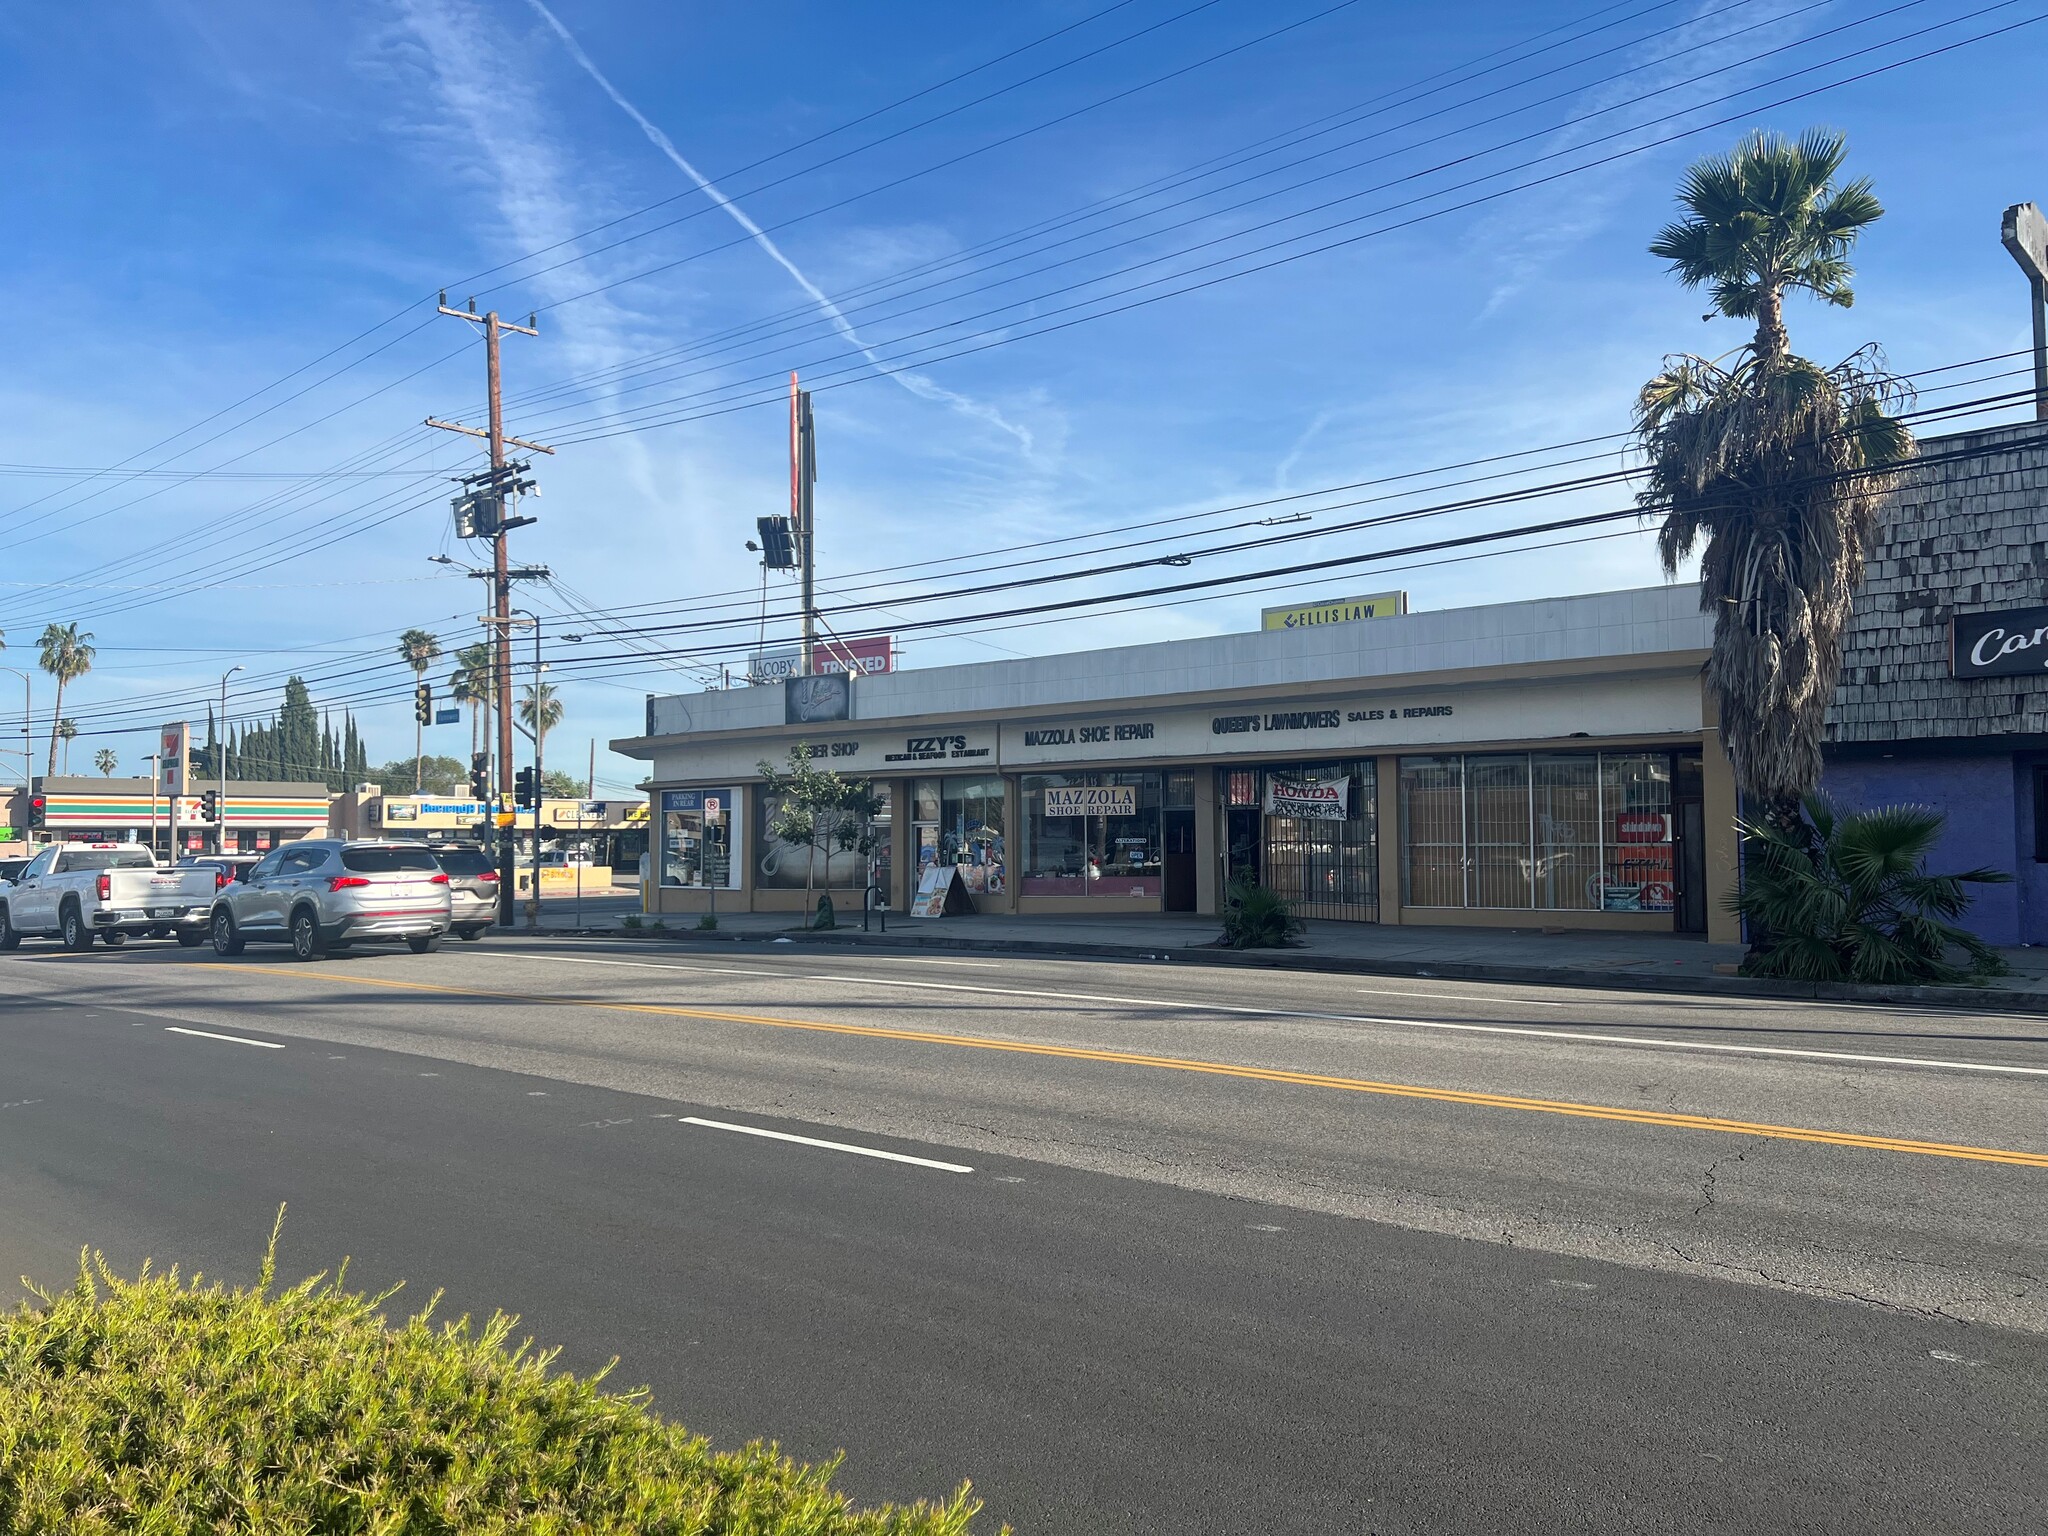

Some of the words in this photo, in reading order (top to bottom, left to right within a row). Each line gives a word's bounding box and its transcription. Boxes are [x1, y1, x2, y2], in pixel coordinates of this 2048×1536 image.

[1300, 609, 1338, 626] ELLIS
[1345, 604, 1375, 621] LAW
[753, 658, 796, 679] JACOBY
[821, 656, 886, 674] TRUSTED
[1212, 714, 1260, 735] QUEEN'S
[1264, 709, 1341, 731] LAWNMOWERS
[1347, 710, 1384, 722] SALES
[1389, 709, 1398, 719] &
[1403, 705, 1453, 718] REPAIRS
[907, 735, 967, 753] IZZY'S
[1024, 728, 1076, 747] MAZZOLA
[1079, 726, 1110, 743] SHOE
[1114, 723, 1154, 741] REPAIR
[791, 744, 828, 760] BBER
[831, 742, 859, 757] SHOP
[918, 751, 947, 760] SEAFOOD
[671, 792, 696, 801] PARKING
[1047, 789, 1133, 806] MAZZOLA
[1272, 784, 1339, 799] HONDA
[680, 799, 694, 807] REAR
[1049, 806, 1080, 815] SHOE
[1088, 805, 1132, 815] REPAIR
